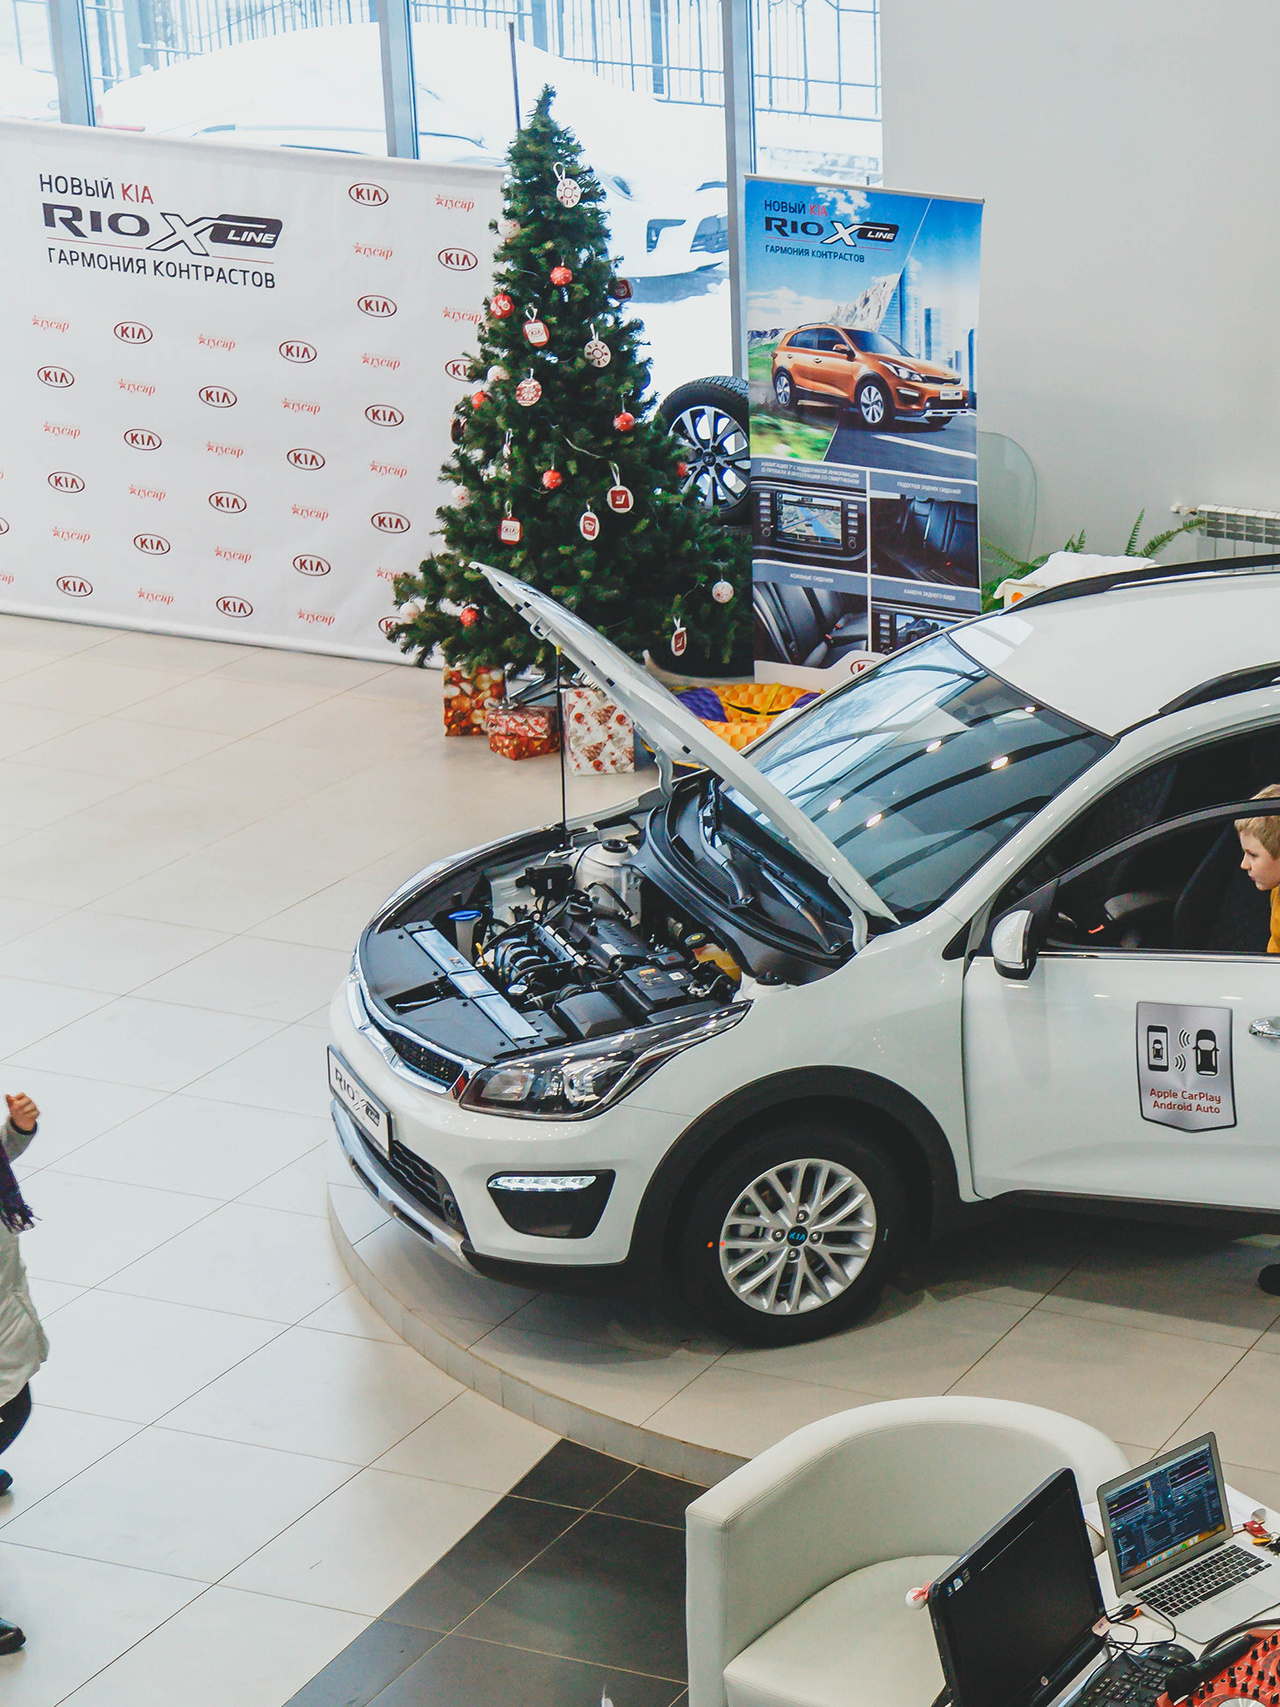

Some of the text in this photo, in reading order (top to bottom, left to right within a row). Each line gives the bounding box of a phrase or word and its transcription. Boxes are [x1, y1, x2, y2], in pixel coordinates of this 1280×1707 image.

[39, 173, 154, 205] НОВЫЙ KIA
[356, 188, 382, 201] KIA
[764, 200, 828, 217] НОВЫЙ KIA
[42, 202, 151, 239] RIO
[226, 229, 277, 245] LINE
[765, 216, 824, 237] RIO
[866, 230, 896, 240] LINE
[445, 253, 471, 266] KIA
[765, 244, 865, 263] ГАРМОНИЯ КОНТРАСТОВ
[48, 247, 276, 289] ГАРМОНИЯ КОНТРАСТОВ
[365, 300, 391, 313] KIA
[121, 326, 146, 340] KIA
[286, 345, 311, 359] KIA
[44, 370, 68, 383] KIA
[205, 390, 230, 404] KIA
[372, 408, 397, 422] KIA
[131, 433, 155, 446] KIA
[294, 453, 319, 466] KIA
[55, 475, 78, 488] KIA
[215, 496, 240, 509] KIA
[378, 516, 403, 529] KIA
[140, 538, 164, 551] KIA
[300, 559, 324, 572] KIA
[62, 580, 86, 592] KIA
[223, 601, 247, 613] KIA
[335, 1067, 355, 1100] RIO
[1150, 1087, 1221, 1104] Apple CarPlay
[1152, 1100, 1221, 1114] Android Auto
